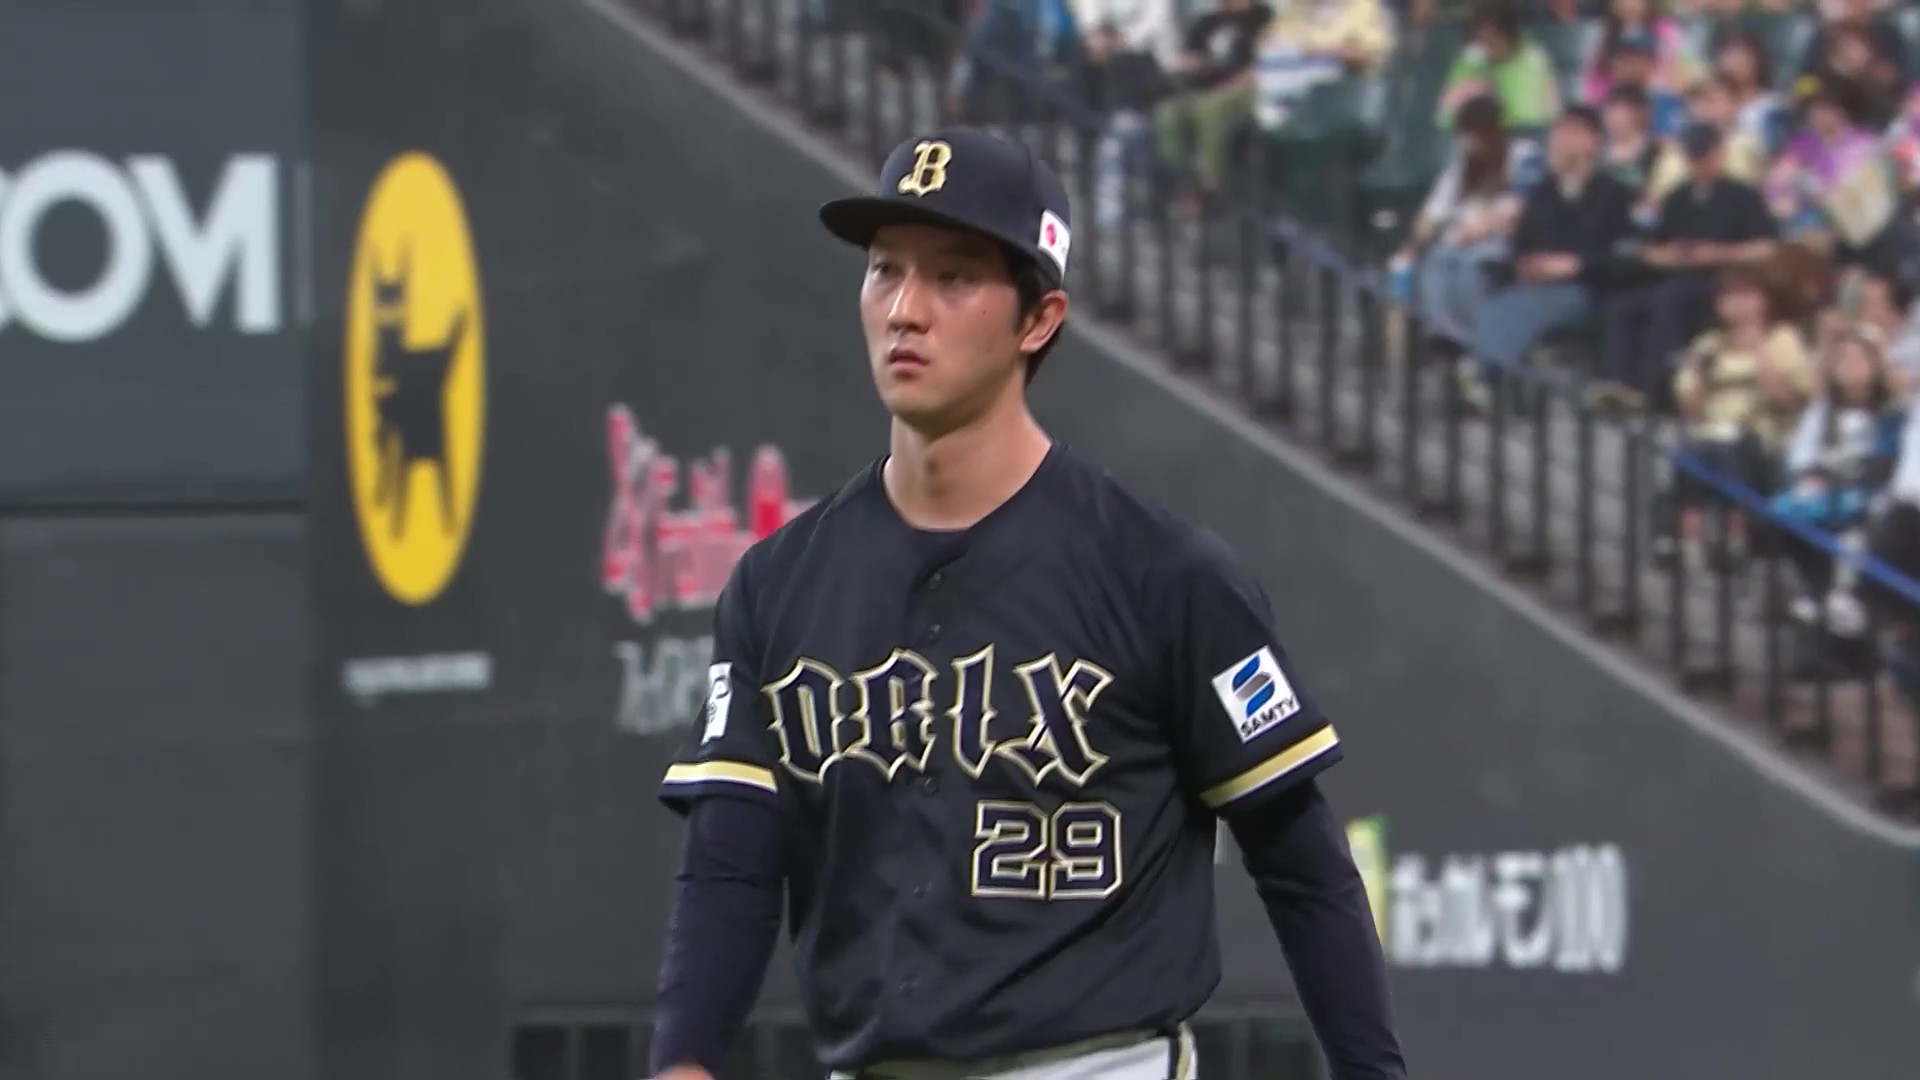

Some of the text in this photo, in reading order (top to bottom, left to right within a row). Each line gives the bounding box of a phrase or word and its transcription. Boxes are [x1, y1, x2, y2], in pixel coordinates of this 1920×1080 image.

[897, 139, 952, 198] B
[0, 149, 281, 341] OM
[760, 641, 1115, 787] ORIX
[1240, 695, 1296, 738] SAMTY
[971, 799, 1122, 902] 29
